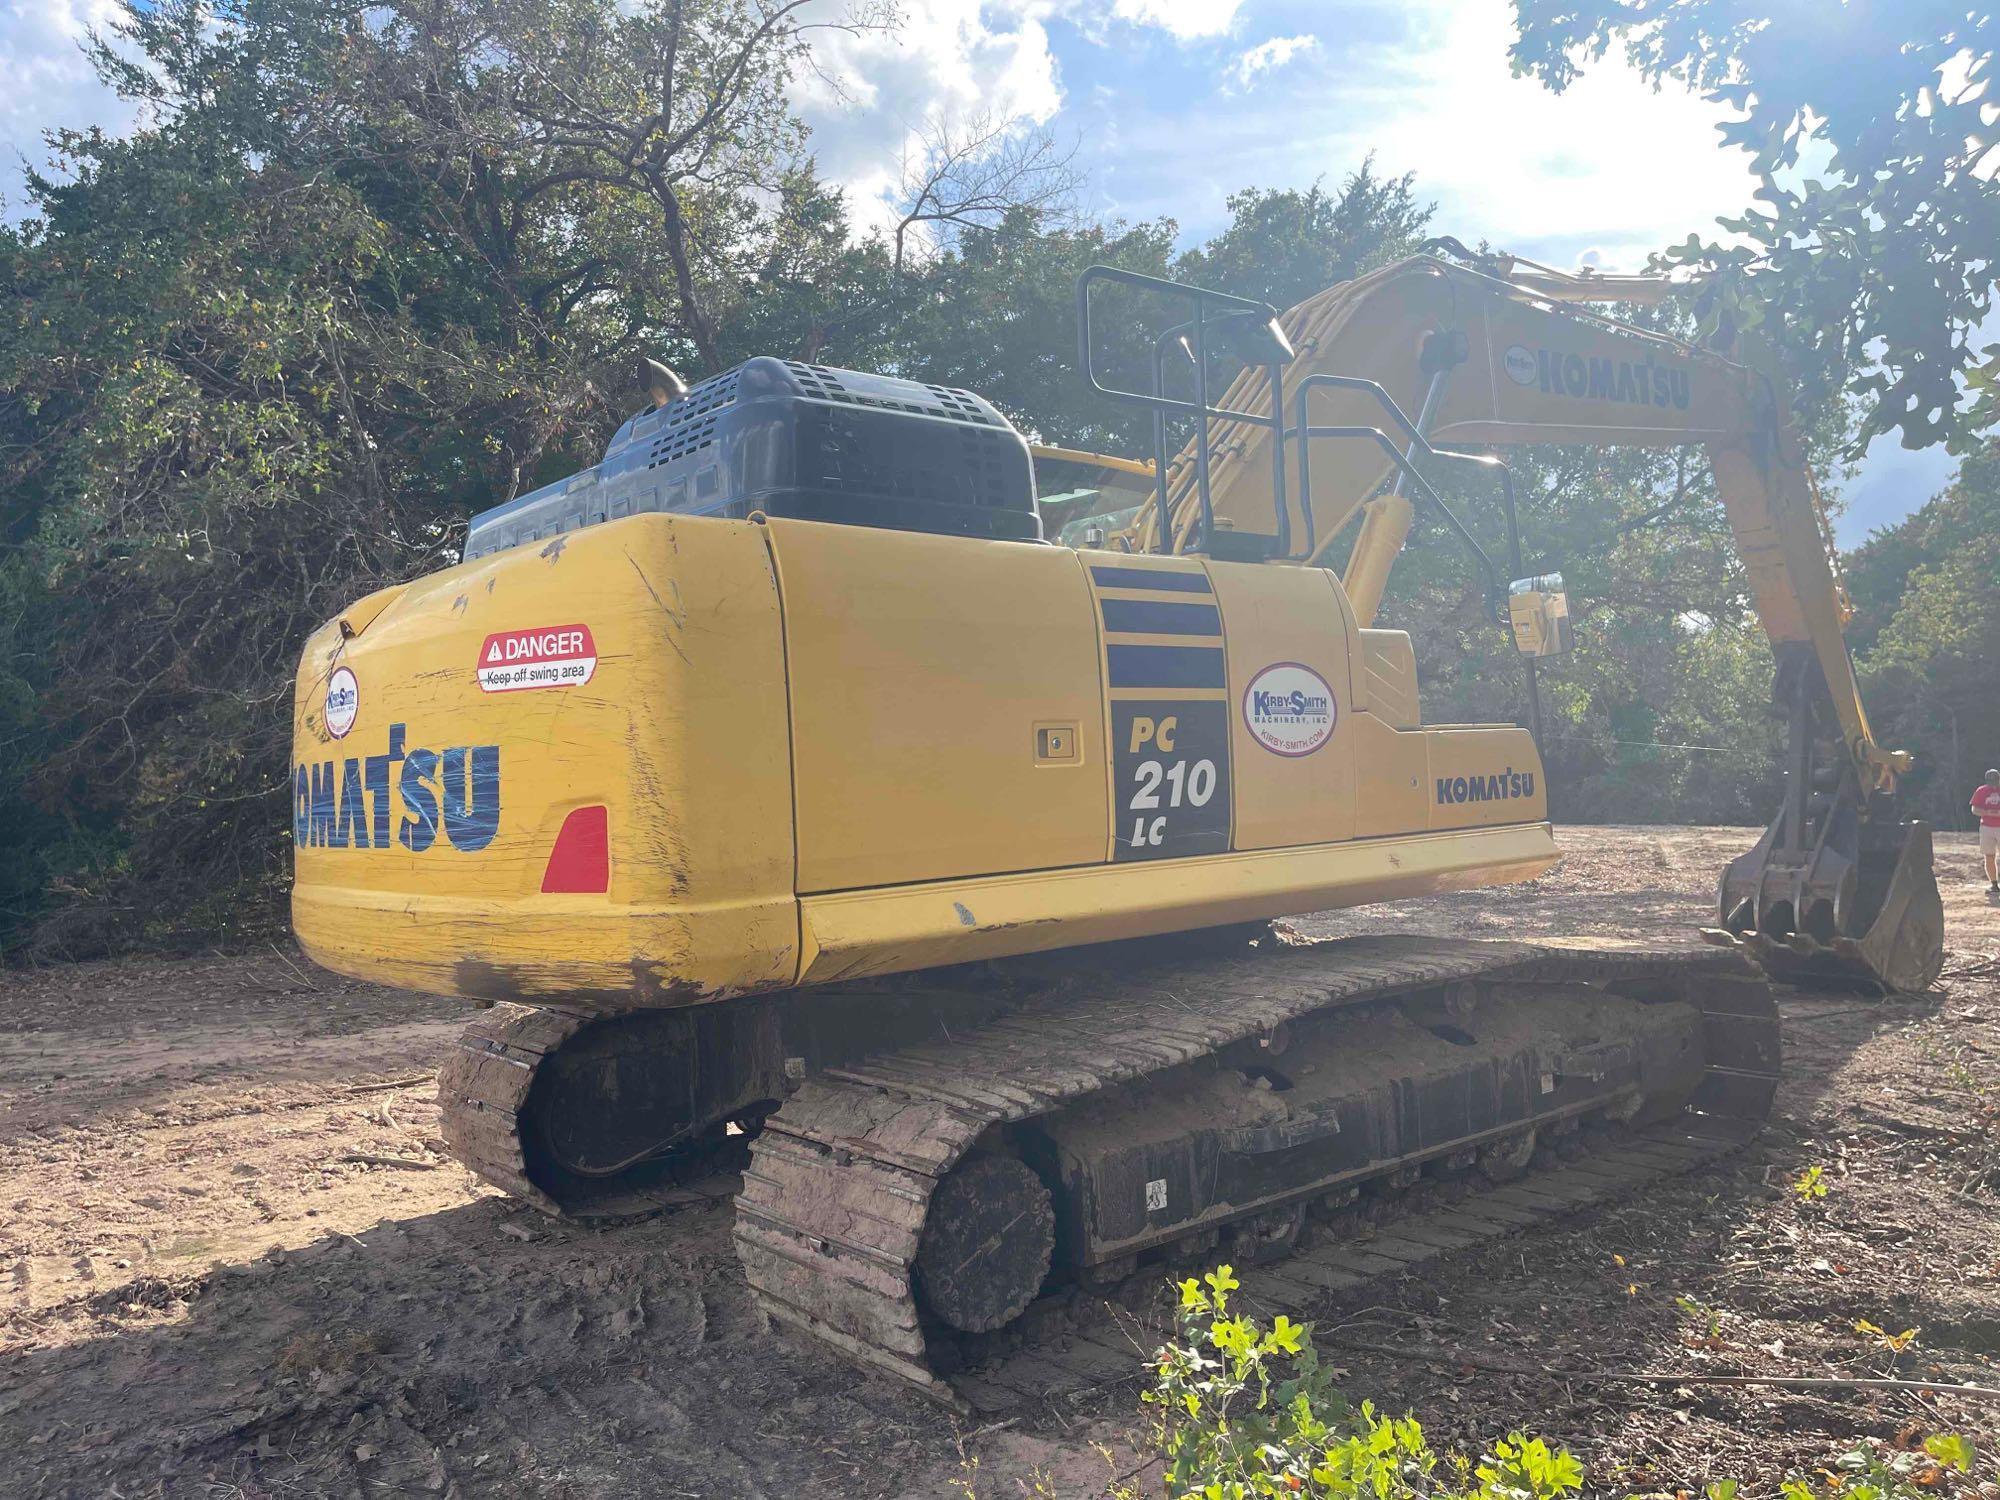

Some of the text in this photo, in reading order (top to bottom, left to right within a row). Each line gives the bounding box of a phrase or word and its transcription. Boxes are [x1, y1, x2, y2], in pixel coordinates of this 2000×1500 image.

[1538, 350, 1690, 411] KOMATSU
[505, 631, 584, 660] DANGER
[487, 665, 585, 686] Keep off swing area
[1130, 716, 1177, 752] PC
[1260, 728, 1325, 750] KIRBY-SMITH.COM
[1130, 759, 1217, 809] 210
[1436, 766, 1534, 804] KOMATSU
[1130, 816, 1167, 847] LC
